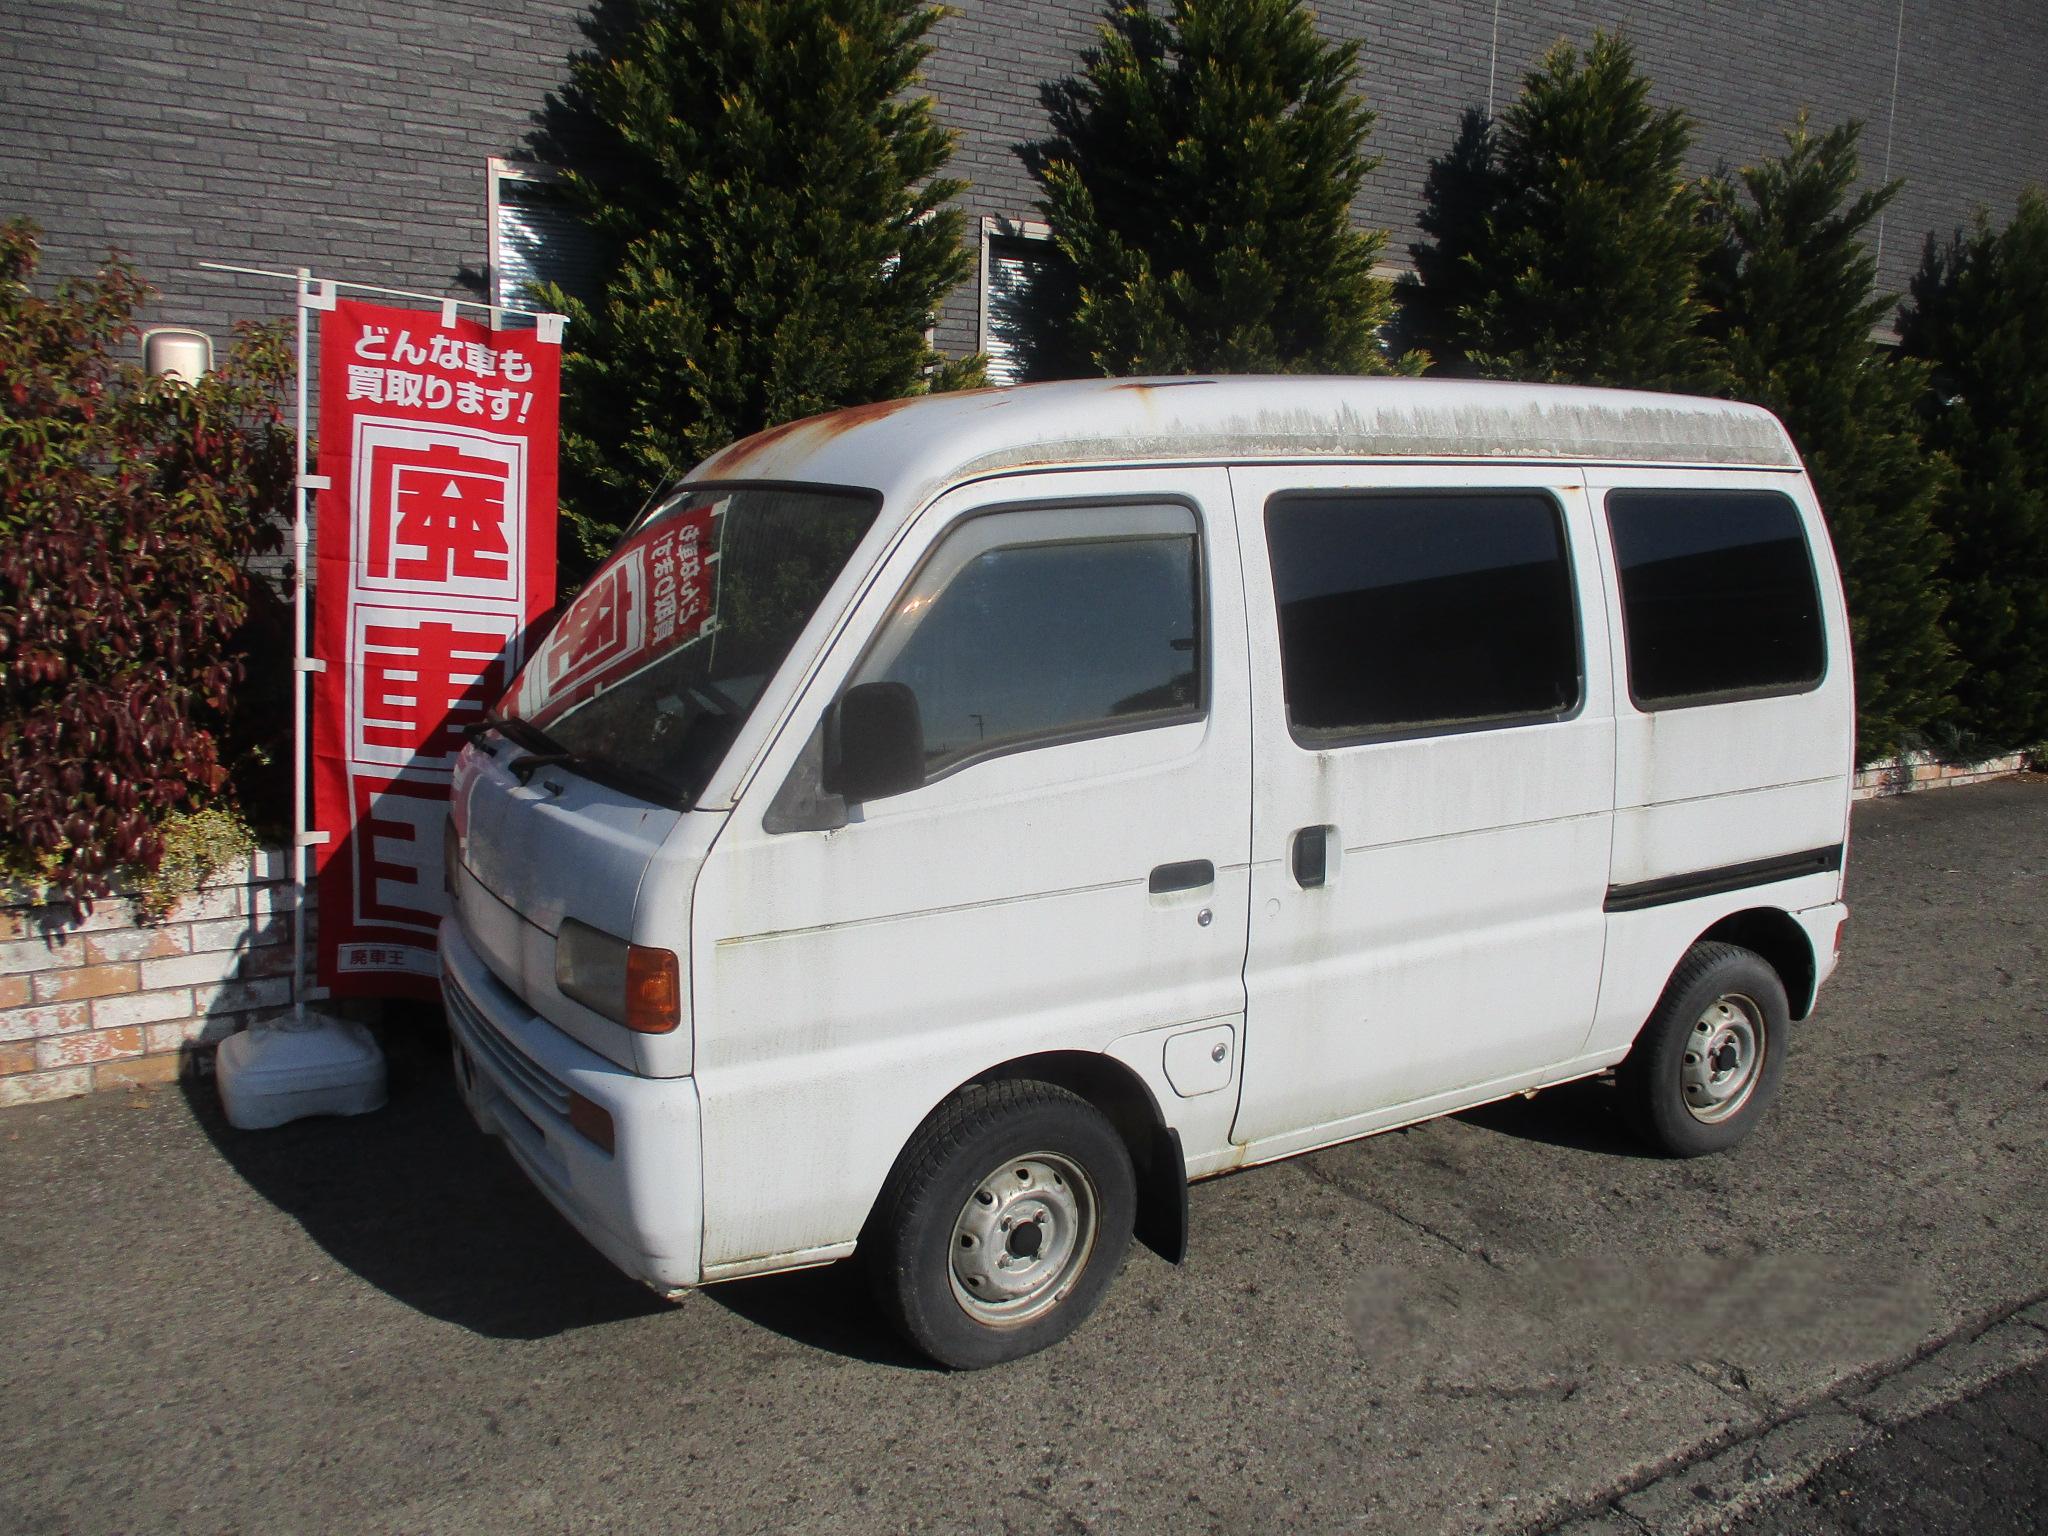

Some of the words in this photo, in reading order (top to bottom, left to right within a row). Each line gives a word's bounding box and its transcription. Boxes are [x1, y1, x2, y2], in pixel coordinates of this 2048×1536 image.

[355, 325, 533, 382] どんな車も
[346, 364, 533, 423] 買取ります!
[352, 949, 405, 966] 廃車王
